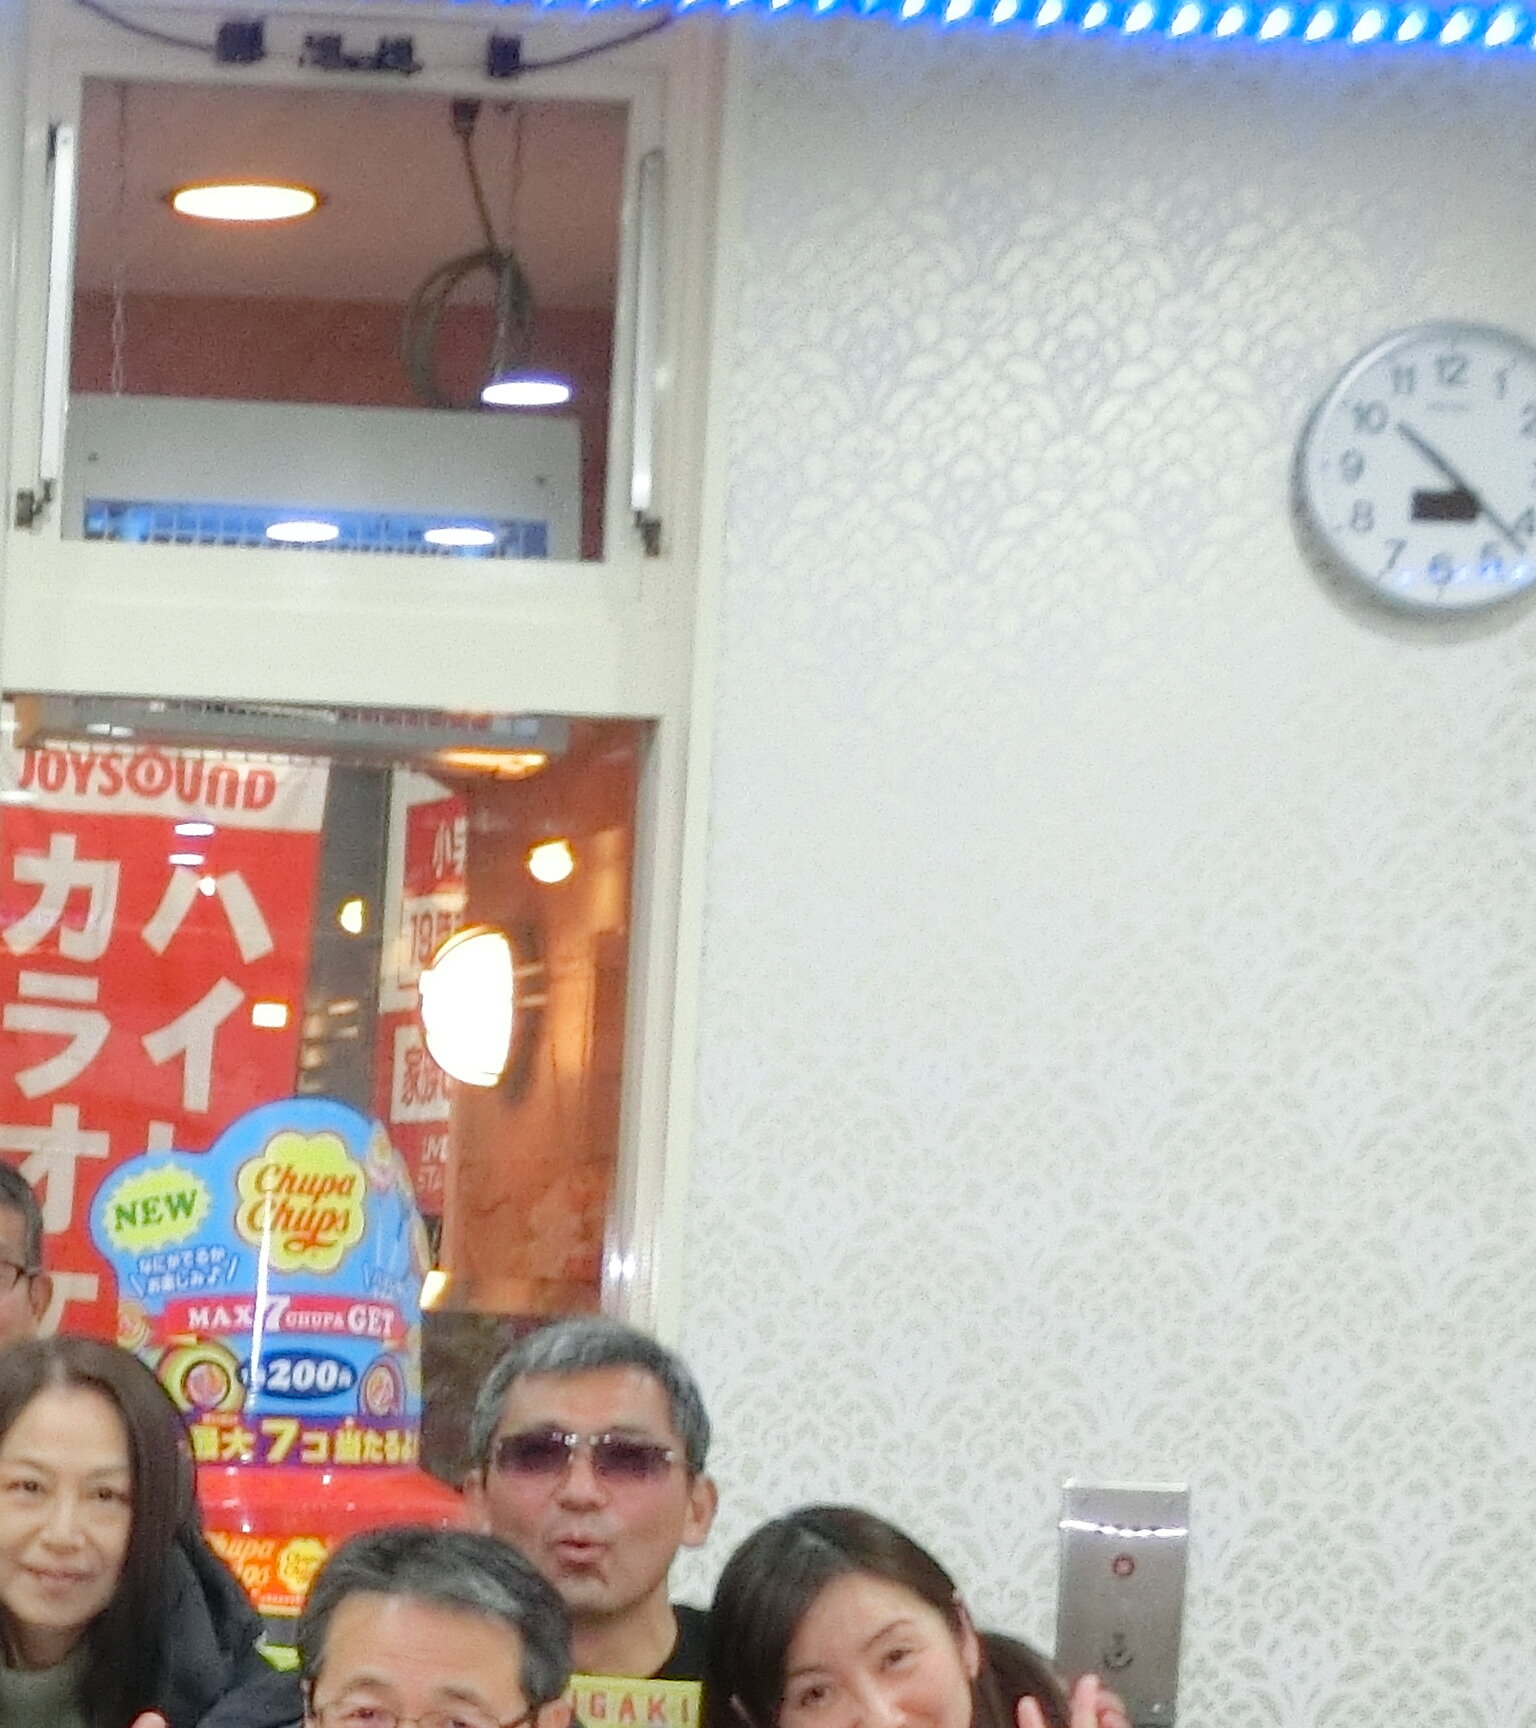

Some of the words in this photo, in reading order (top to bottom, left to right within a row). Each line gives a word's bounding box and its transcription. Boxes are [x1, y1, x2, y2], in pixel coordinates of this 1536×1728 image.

[18, 740, 278, 812] JOYSOUND
[253, 1162, 356, 1202] Chupa
[114, 1187, 198, 1234] NEW
[245, 1197, 351, 1252] Chups
[187, 1305, 253, 1332] MAX
[262, 1294, 291, 1332] 7
[346, 1303, 396, 1338] GET
[573, 1690, 690, 1725] GAKI
